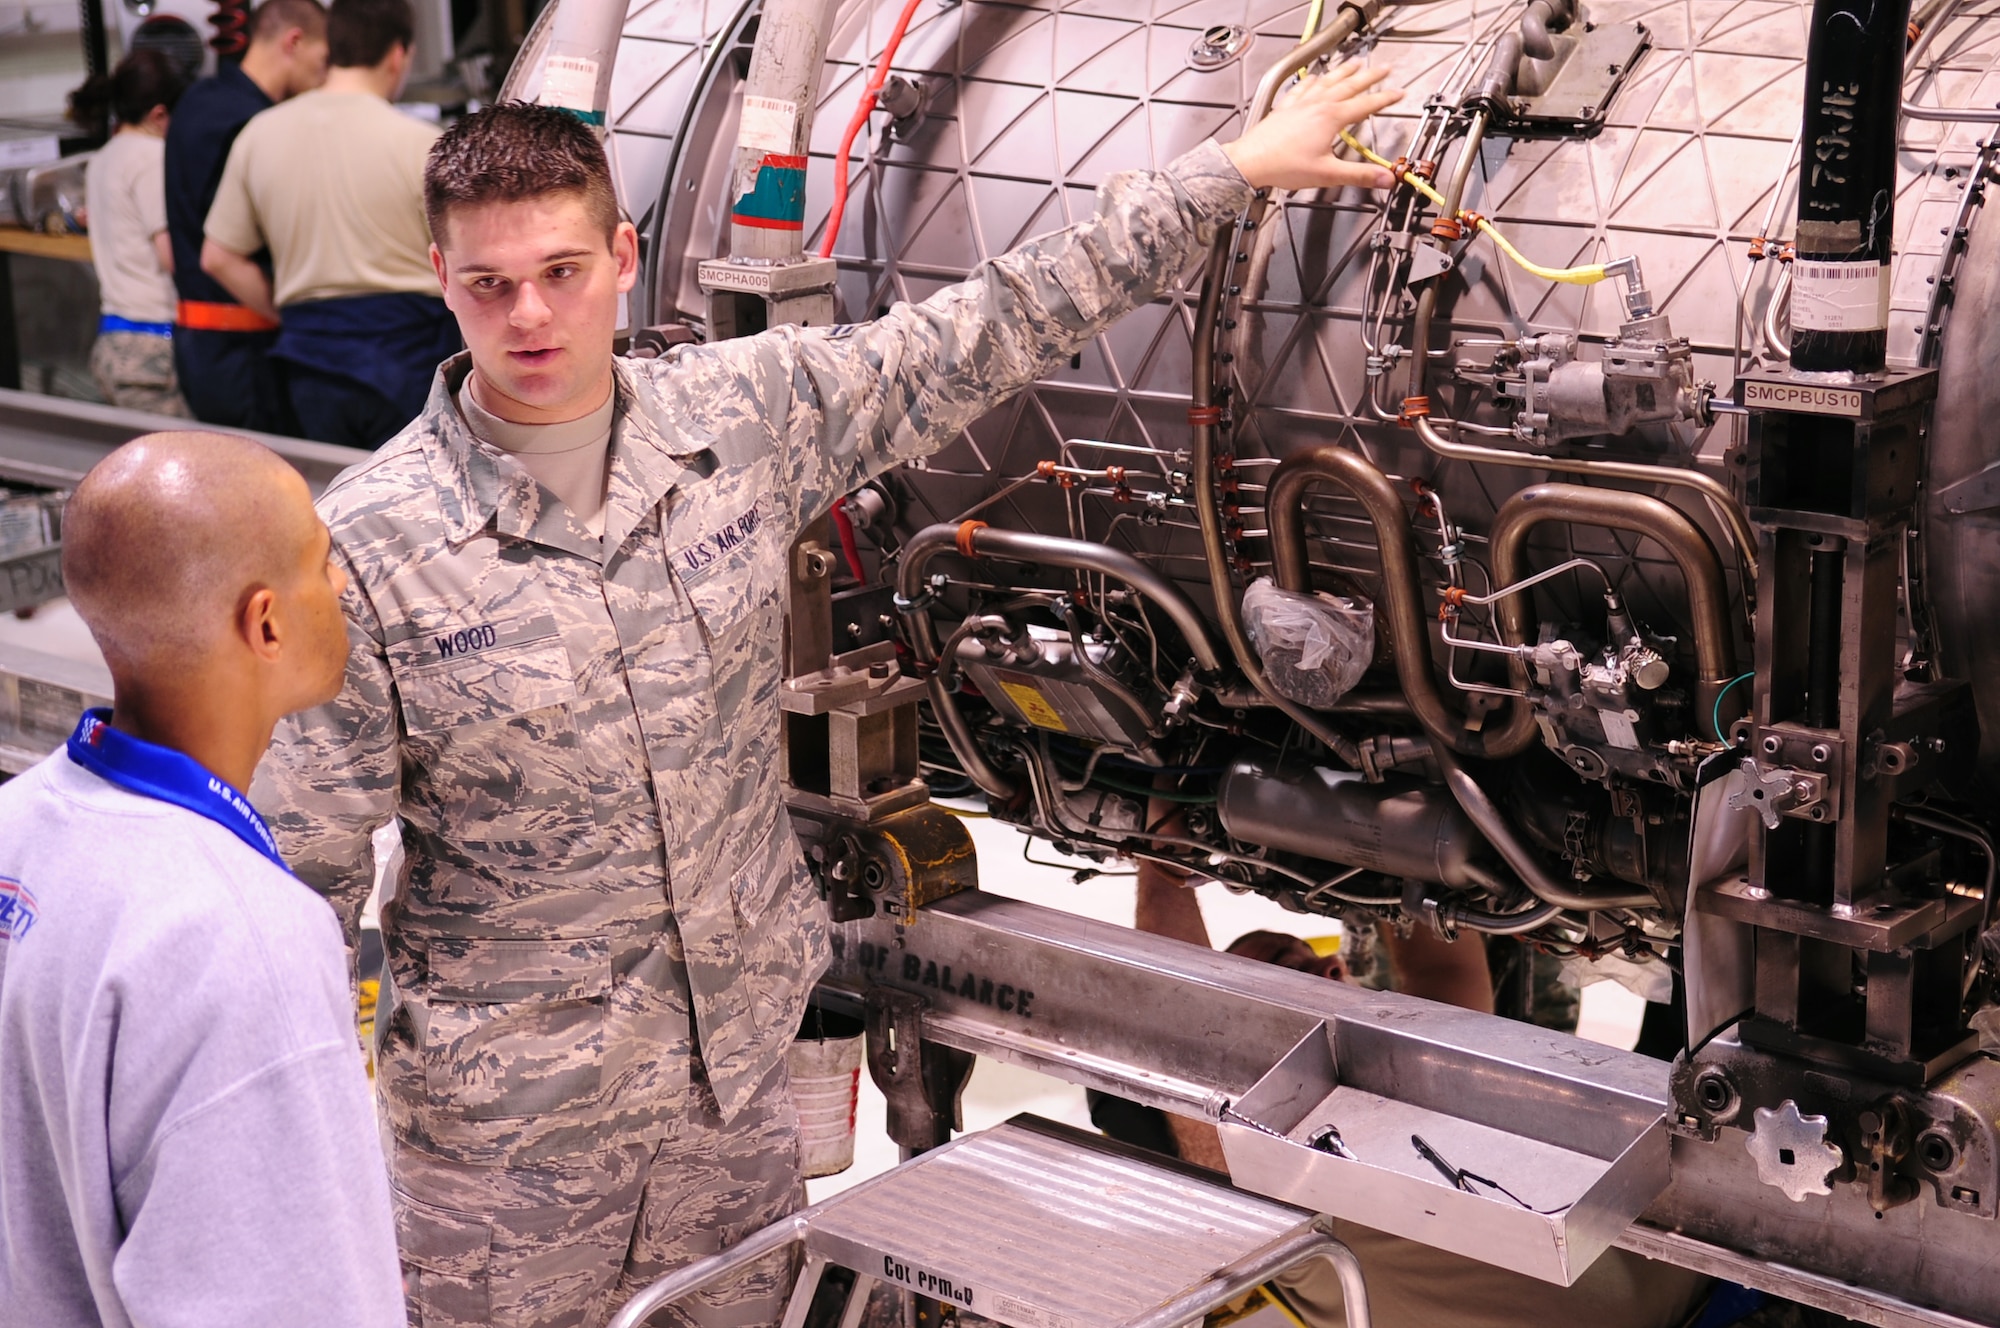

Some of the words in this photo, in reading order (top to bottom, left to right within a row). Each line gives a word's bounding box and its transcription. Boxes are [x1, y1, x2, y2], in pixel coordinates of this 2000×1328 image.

[699, 269, 768, 287] SMCPHA009
[1746, 385, 1860, 408] SMCPBUS10
[684, 542, 716, 569] U.S.
[716, 525, 741, 553] AIR
[434, 625, 496, 659] WOOD
[231, 796, 251, 819] AIR
[858, 941, 890, 971] OF
[903, 953, 1036, 1018] BALANCE
